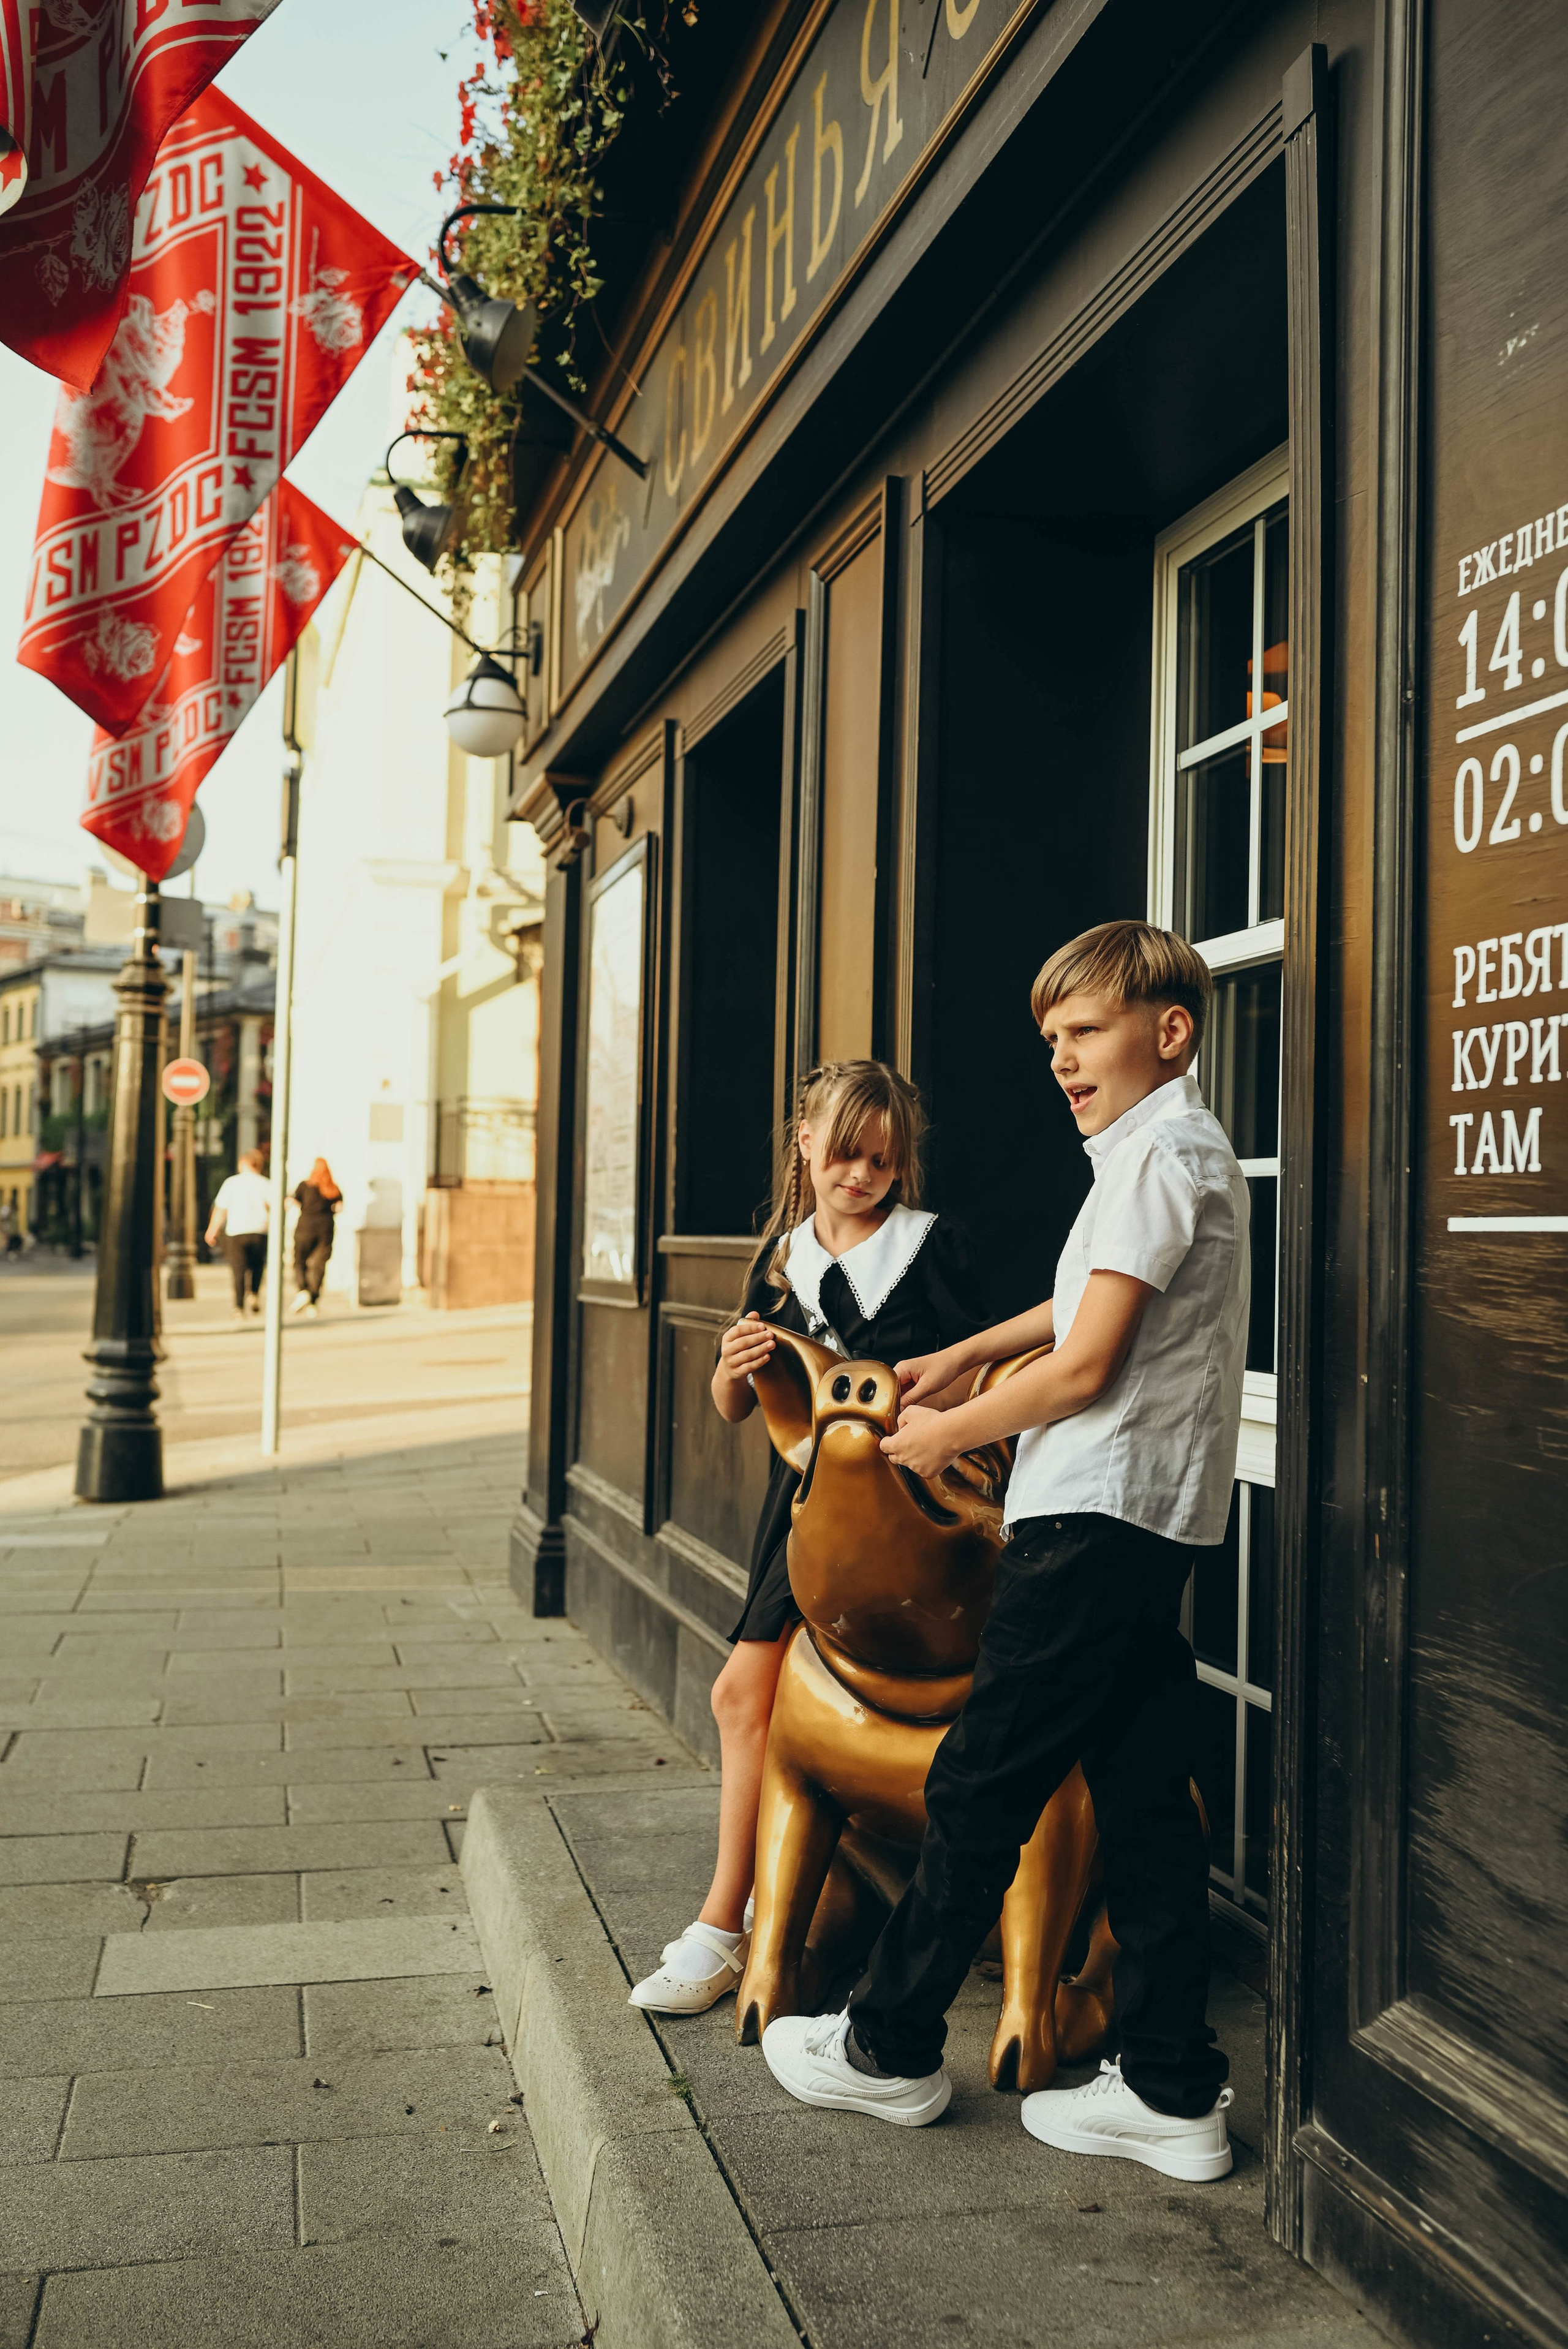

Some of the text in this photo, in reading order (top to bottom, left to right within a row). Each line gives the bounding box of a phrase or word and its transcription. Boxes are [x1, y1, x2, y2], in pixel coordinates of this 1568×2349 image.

[135, 152, 224, 247] ZDC
[663, 0, 903, 497] СВИНЬЯ
[227, 200, 285, 459] FCSM 1922
[115, 464, 223, 581] PZDC
[1457, 502, 1568, 597] ЕЖЕДНЕ
[224, 503, 264, 685] FCSM 192
[88, 739, 142, 802] VSM
[1449, 1107, 1543, 1175] ТАМ
